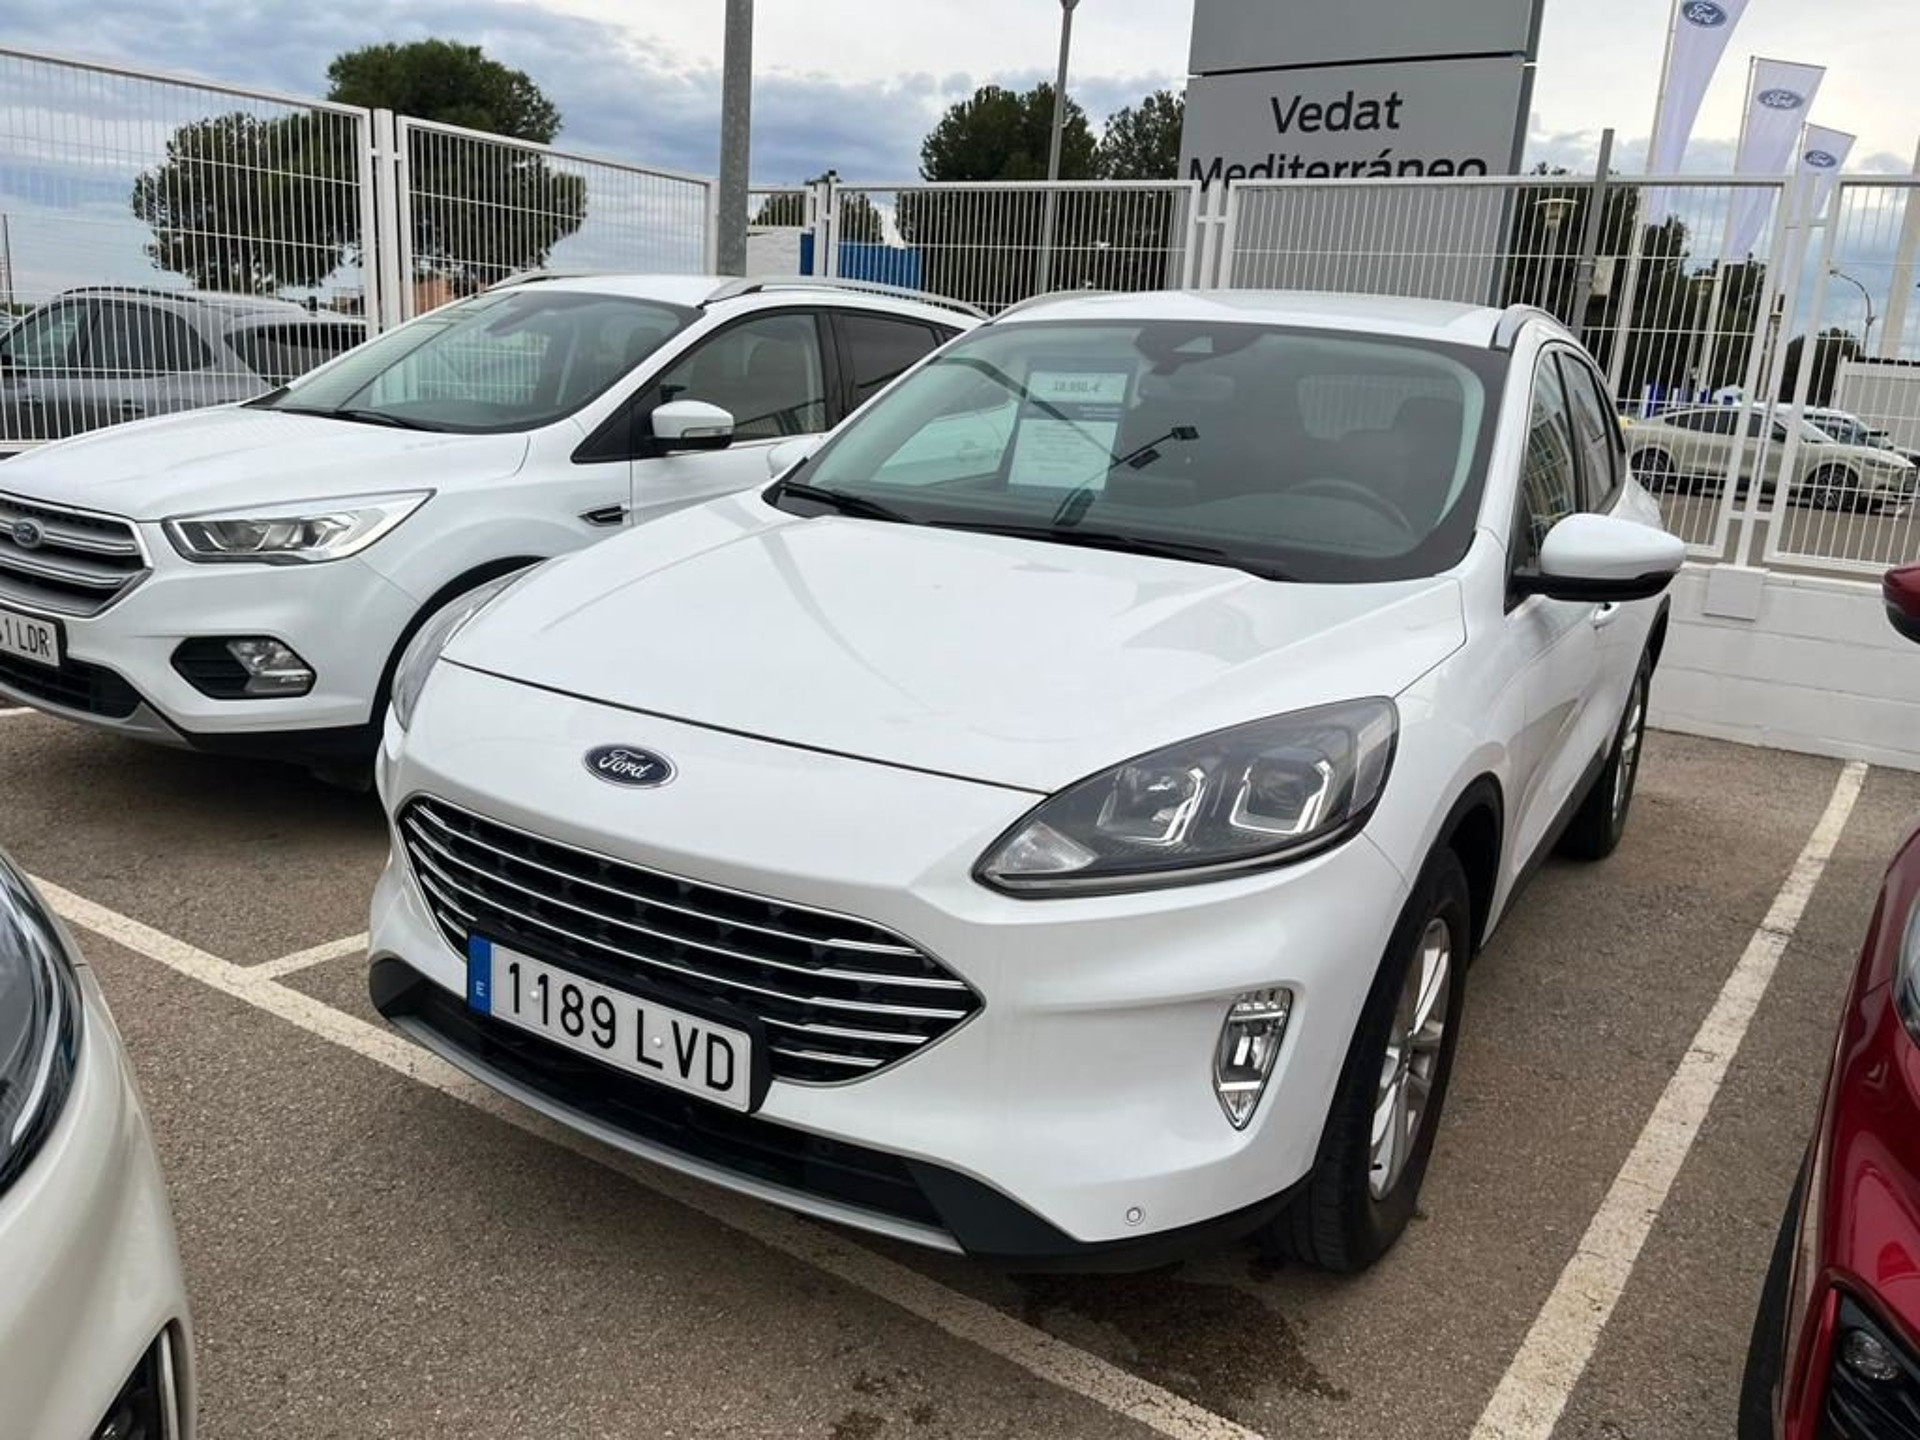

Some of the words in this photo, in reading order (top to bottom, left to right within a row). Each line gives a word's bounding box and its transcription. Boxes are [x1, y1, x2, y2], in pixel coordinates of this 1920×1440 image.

[1688, 3, 1718, 23] Ford
[1271, 91, 1403, 134] Vedat
[17, 620, 50, 658] LDR
[599, 749, 654, 779] Ford
[509, 962, 616, 1049] 1189
[637, 1009, 735, 1091] LVD
